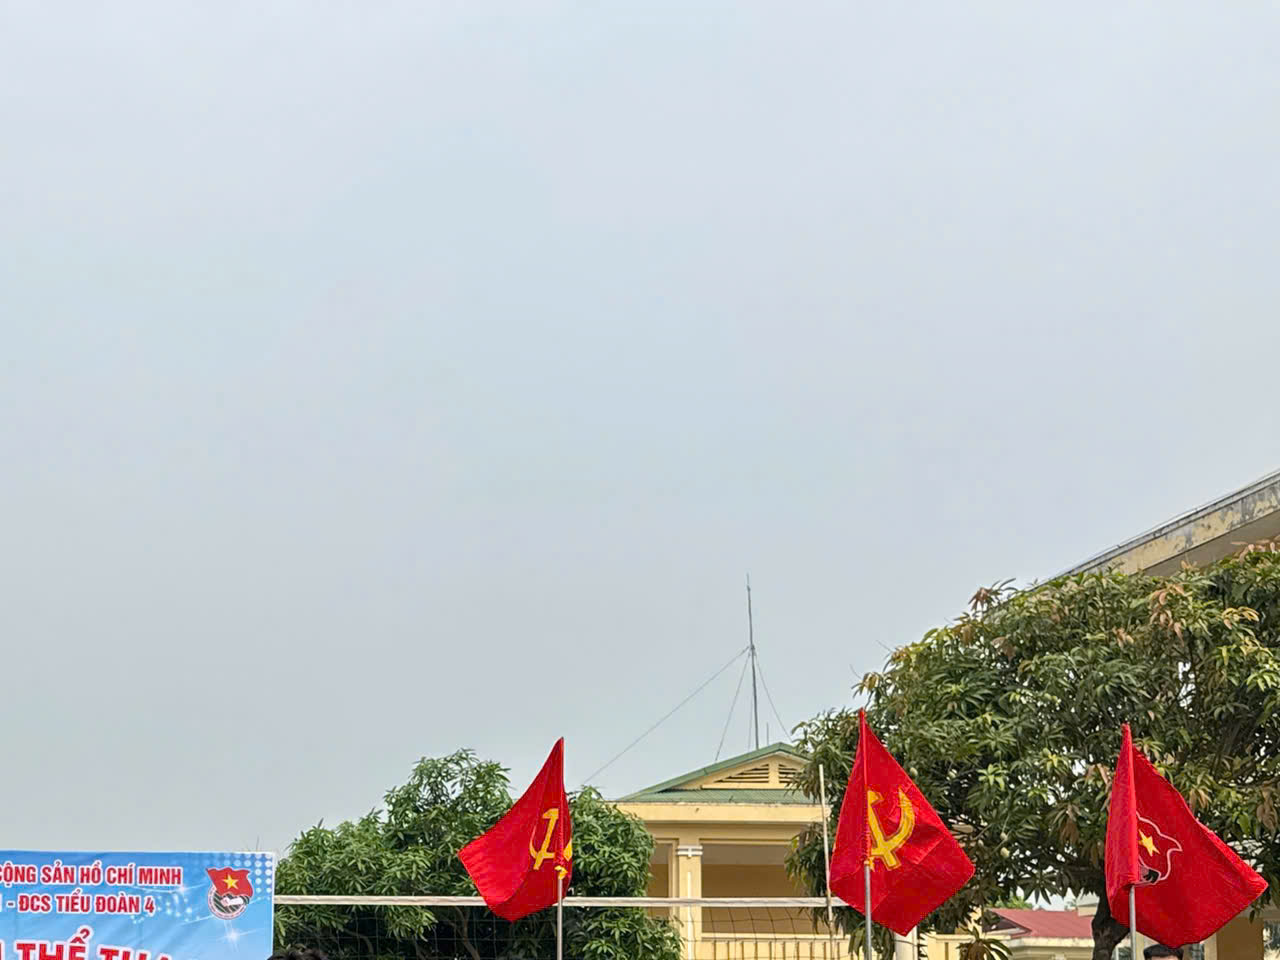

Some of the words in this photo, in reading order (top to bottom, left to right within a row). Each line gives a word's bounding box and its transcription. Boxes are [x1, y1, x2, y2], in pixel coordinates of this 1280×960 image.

[41, 862, 75, 884] SẢN
[79, 861, 102, 884] HỒ
[106, 864, 133, 885] CHÍ
[138, 867, 182, 885] MINH
[18, 894, 51, 912] ĐCS
[56, 888, 91, 912] TIỂU
[95, 892, 140, 913] ĐOÀN
[144, 897, 155, 913] 4
